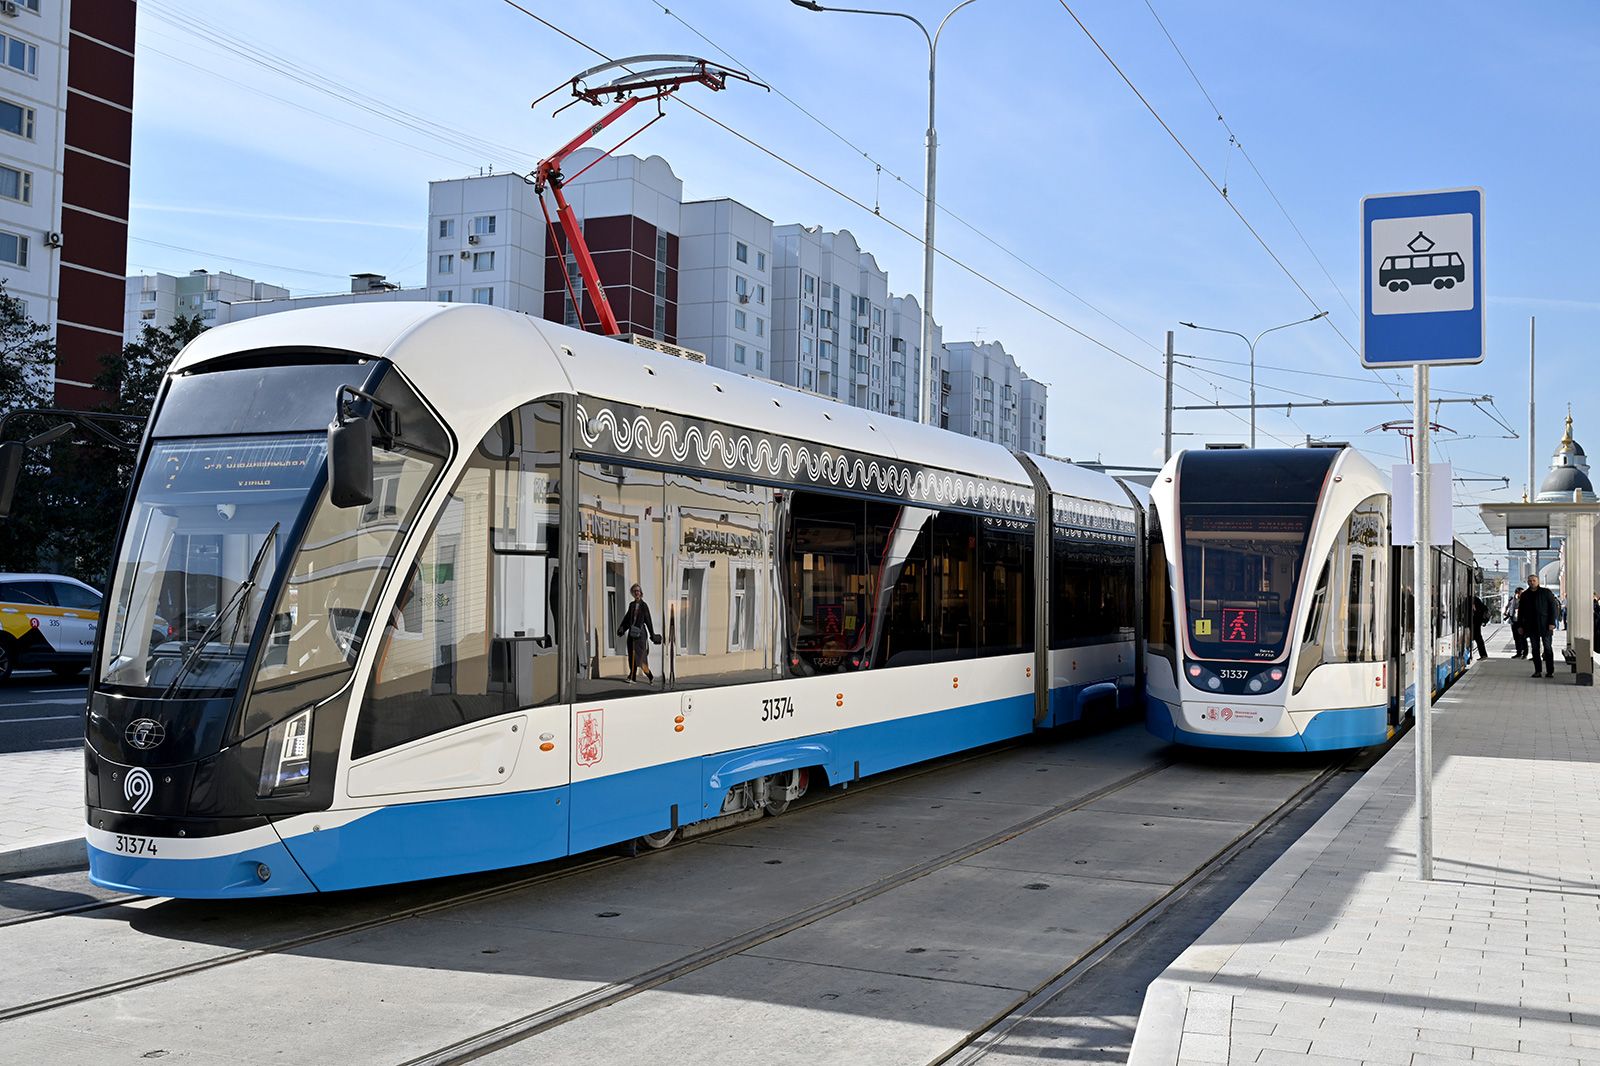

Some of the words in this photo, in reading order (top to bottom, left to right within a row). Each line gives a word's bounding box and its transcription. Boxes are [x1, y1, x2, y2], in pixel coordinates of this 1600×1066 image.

[49, 619, 60, 627] 335
[1220, 669, 1249, 680] 31337
[761, 696, 794, 721] 31374
[116, 835, 158, 855] 31374
